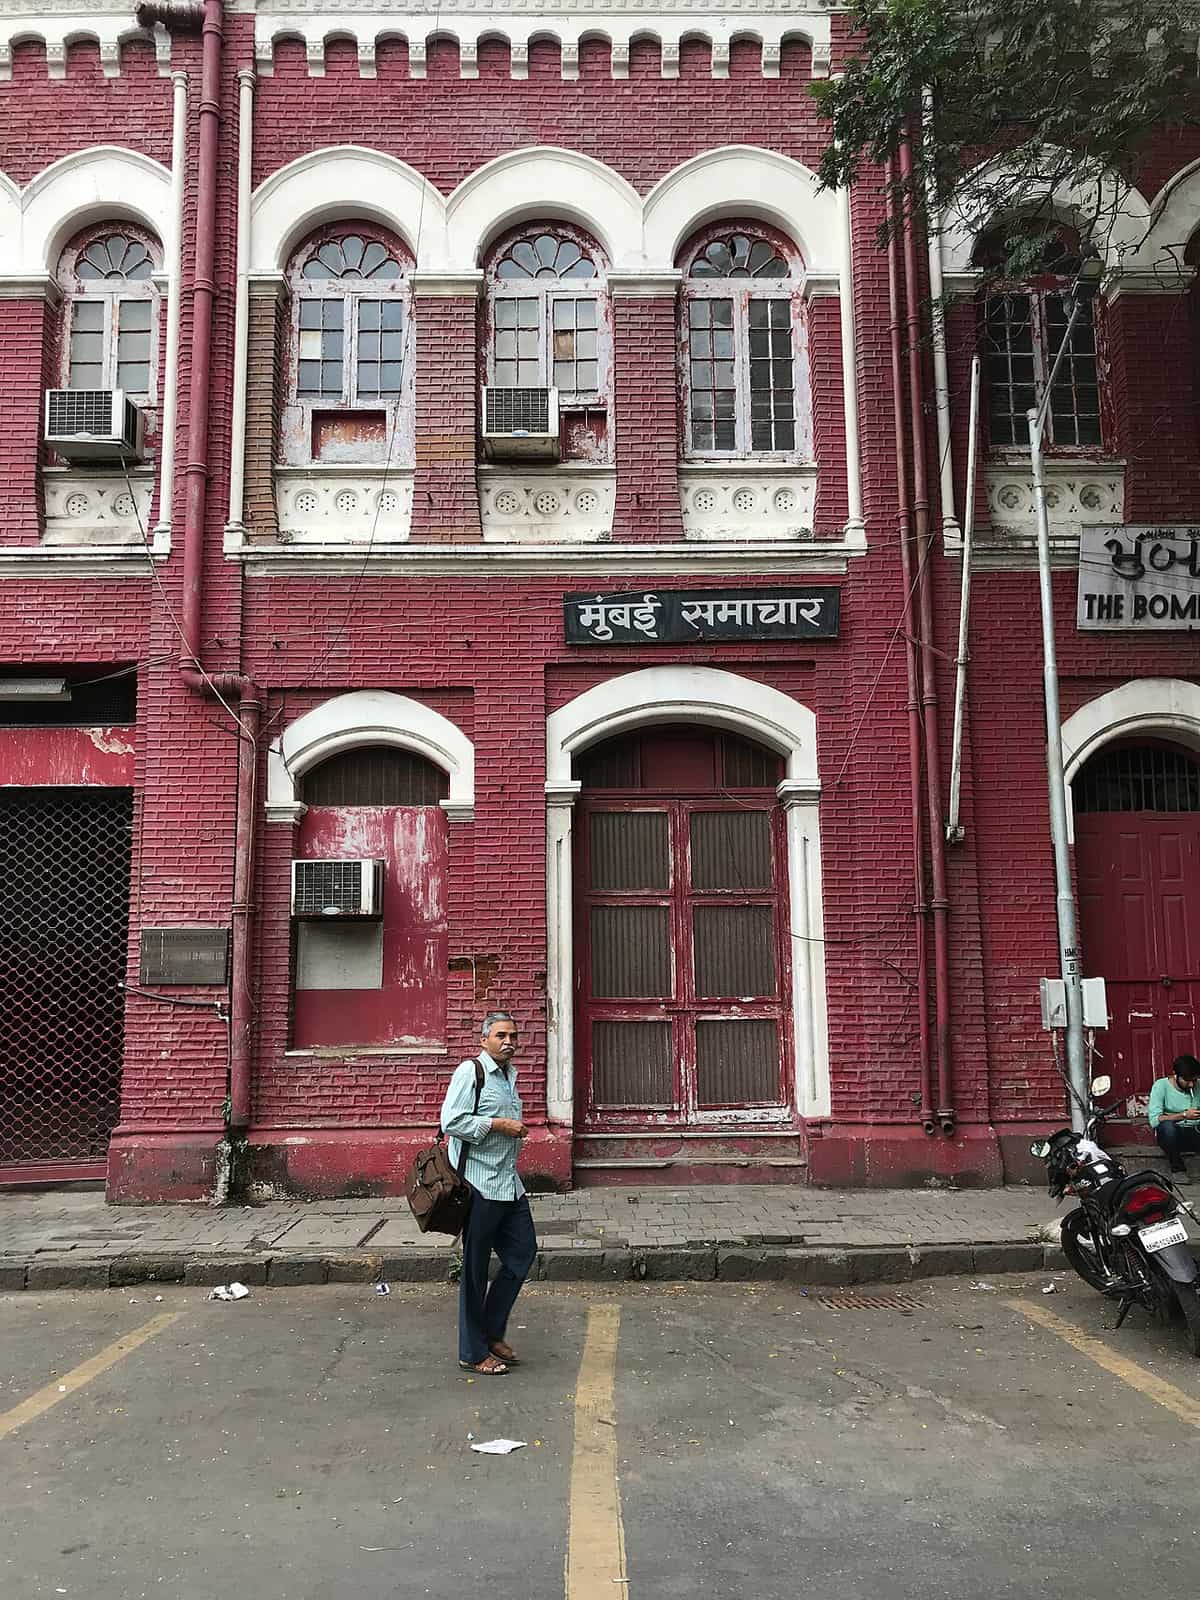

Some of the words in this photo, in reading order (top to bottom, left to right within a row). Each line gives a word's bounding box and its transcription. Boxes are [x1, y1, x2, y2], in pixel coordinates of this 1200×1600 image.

[577, 594, 662, 640] मुंबई
[681, 598, 825, 630] समाचार
[1084, 593, 1124, 620] THE
[1133, 593, 1200, 620] BOM
